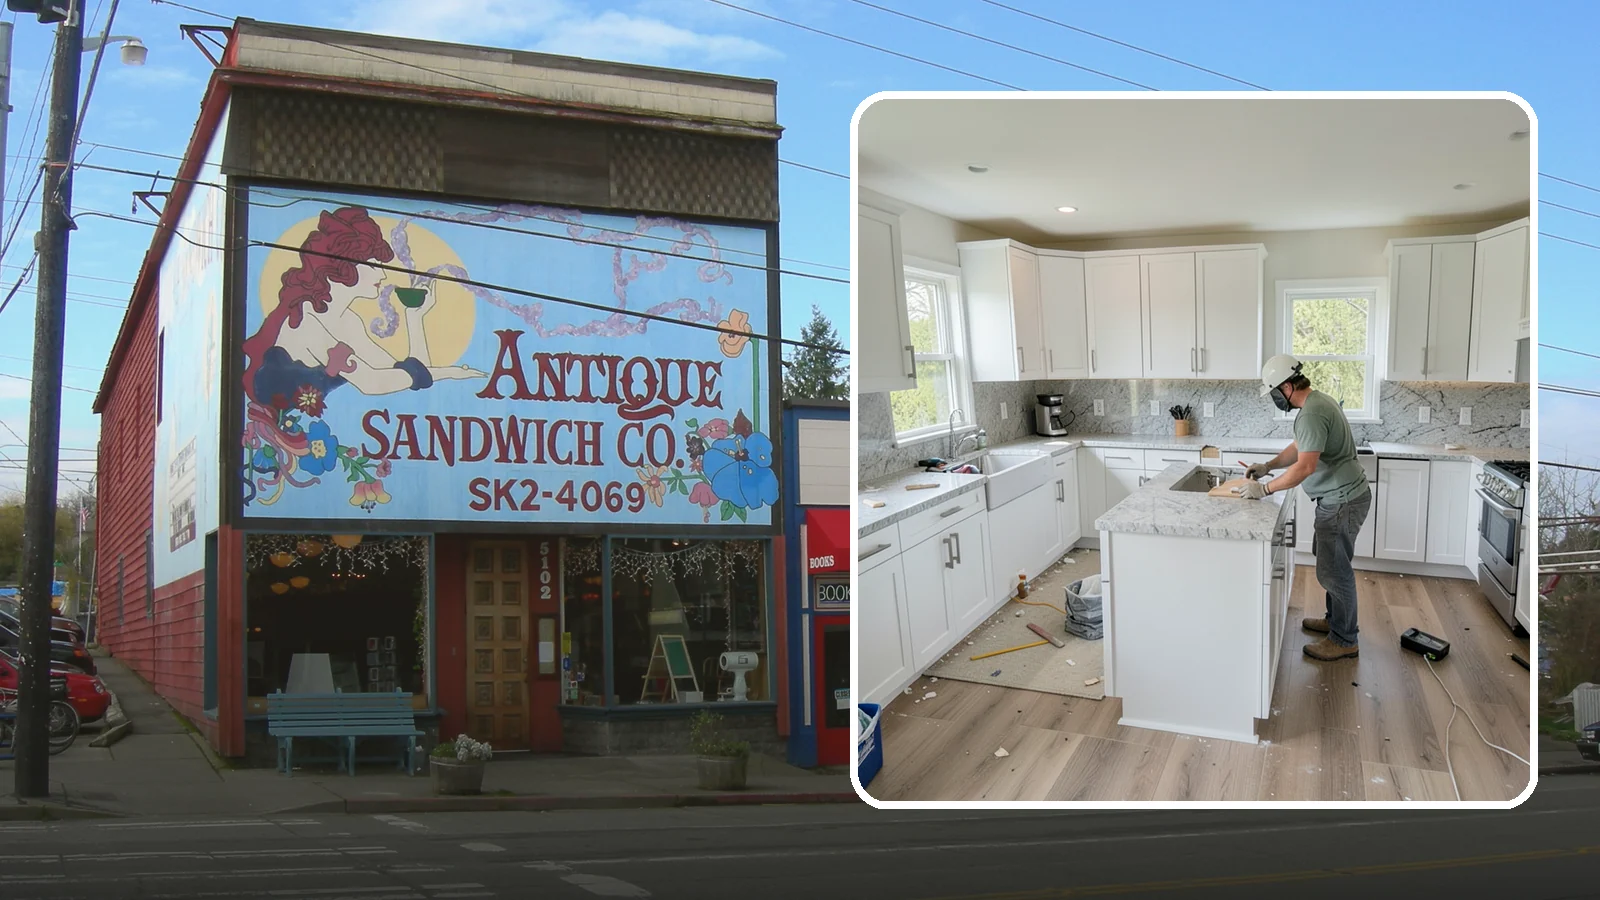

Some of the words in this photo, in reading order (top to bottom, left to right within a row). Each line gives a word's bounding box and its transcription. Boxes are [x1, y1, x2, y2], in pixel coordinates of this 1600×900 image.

[476, 329, 723, 420] ANTIQUE
[361, 409, 604, 466] SANDWICH
[617, 422, 684, 467] CO.
[468, 477, 645, 513] SK2-4069
[540, 542, 551, 599] 5102
[809, 555, 834, 568] BOOKS
